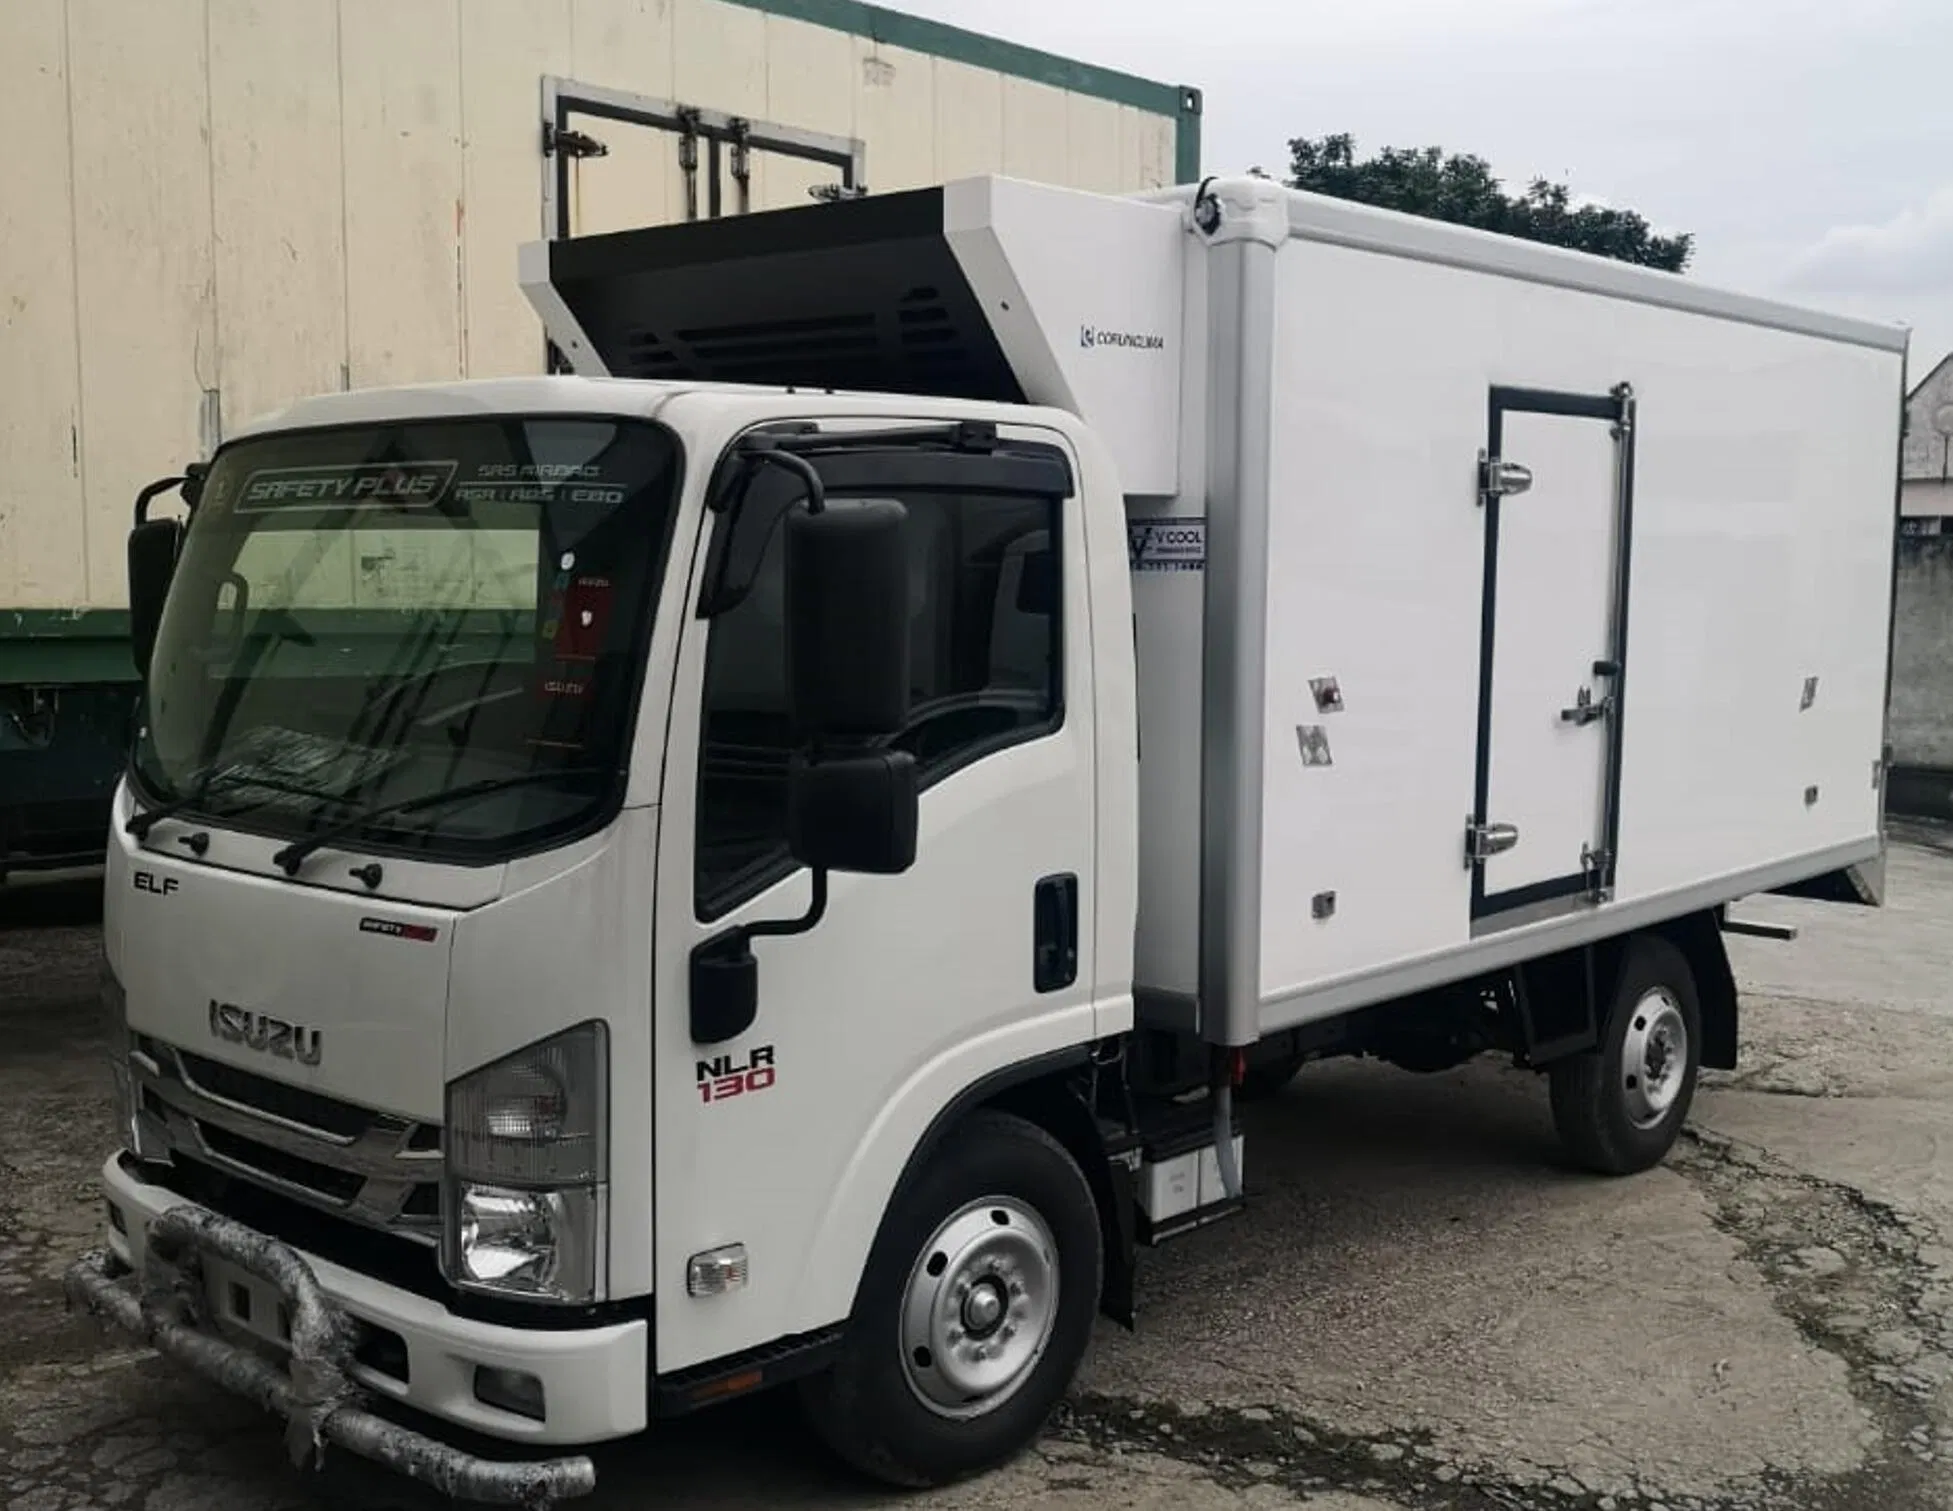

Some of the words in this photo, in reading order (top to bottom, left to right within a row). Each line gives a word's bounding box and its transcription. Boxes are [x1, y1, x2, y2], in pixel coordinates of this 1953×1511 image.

[248, 478, 350, 500] SAFETY
[353, 474, 438, 496] PLUS
[1166, 531, 1201, 544] COOL
[134, 871, 179, 896] ELF
[209, 999, 322, 1066] ISUZU
[697, 1044, 774, 1082] NLR
[697, 1067, 775, 1103] 130
